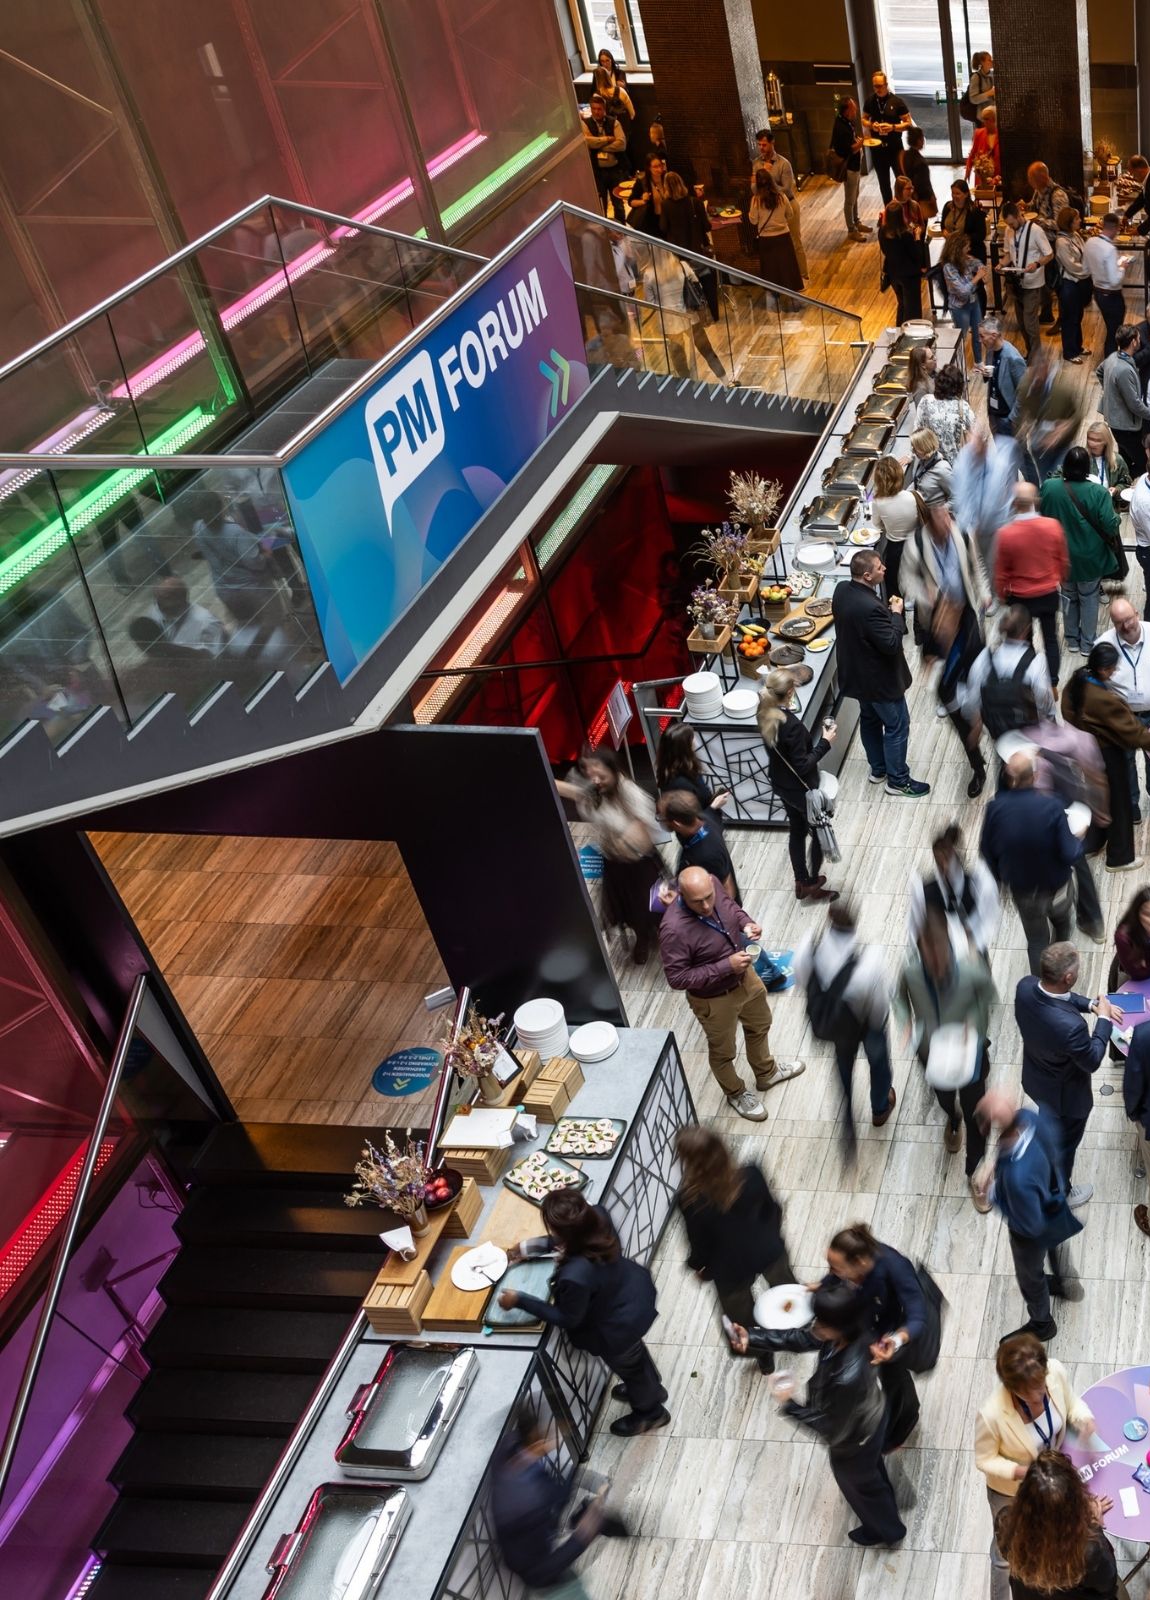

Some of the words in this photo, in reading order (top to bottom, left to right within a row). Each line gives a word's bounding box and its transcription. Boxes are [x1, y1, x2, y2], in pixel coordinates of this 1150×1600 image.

[373, 378, 437, 477] PM
[438, 267, 548, 412] FORUM
[1093, 1443, 1130, 1472] FORUM
